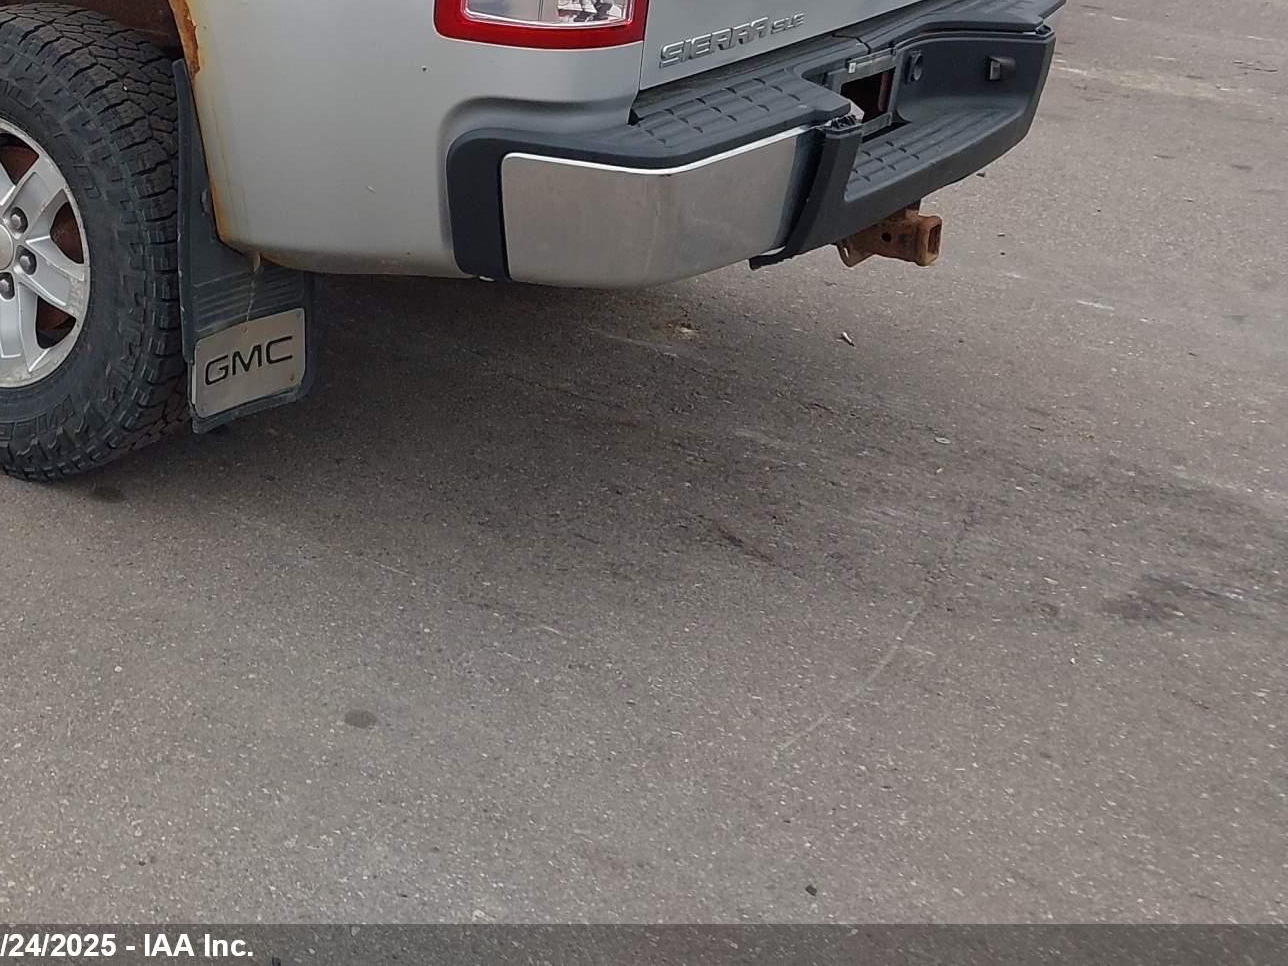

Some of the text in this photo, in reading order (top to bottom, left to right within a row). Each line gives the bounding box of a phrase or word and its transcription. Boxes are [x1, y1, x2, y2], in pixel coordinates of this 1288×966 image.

[658, 12, 806, 69] SIERRA SLE
[204, 335, 294, 386] GMC
